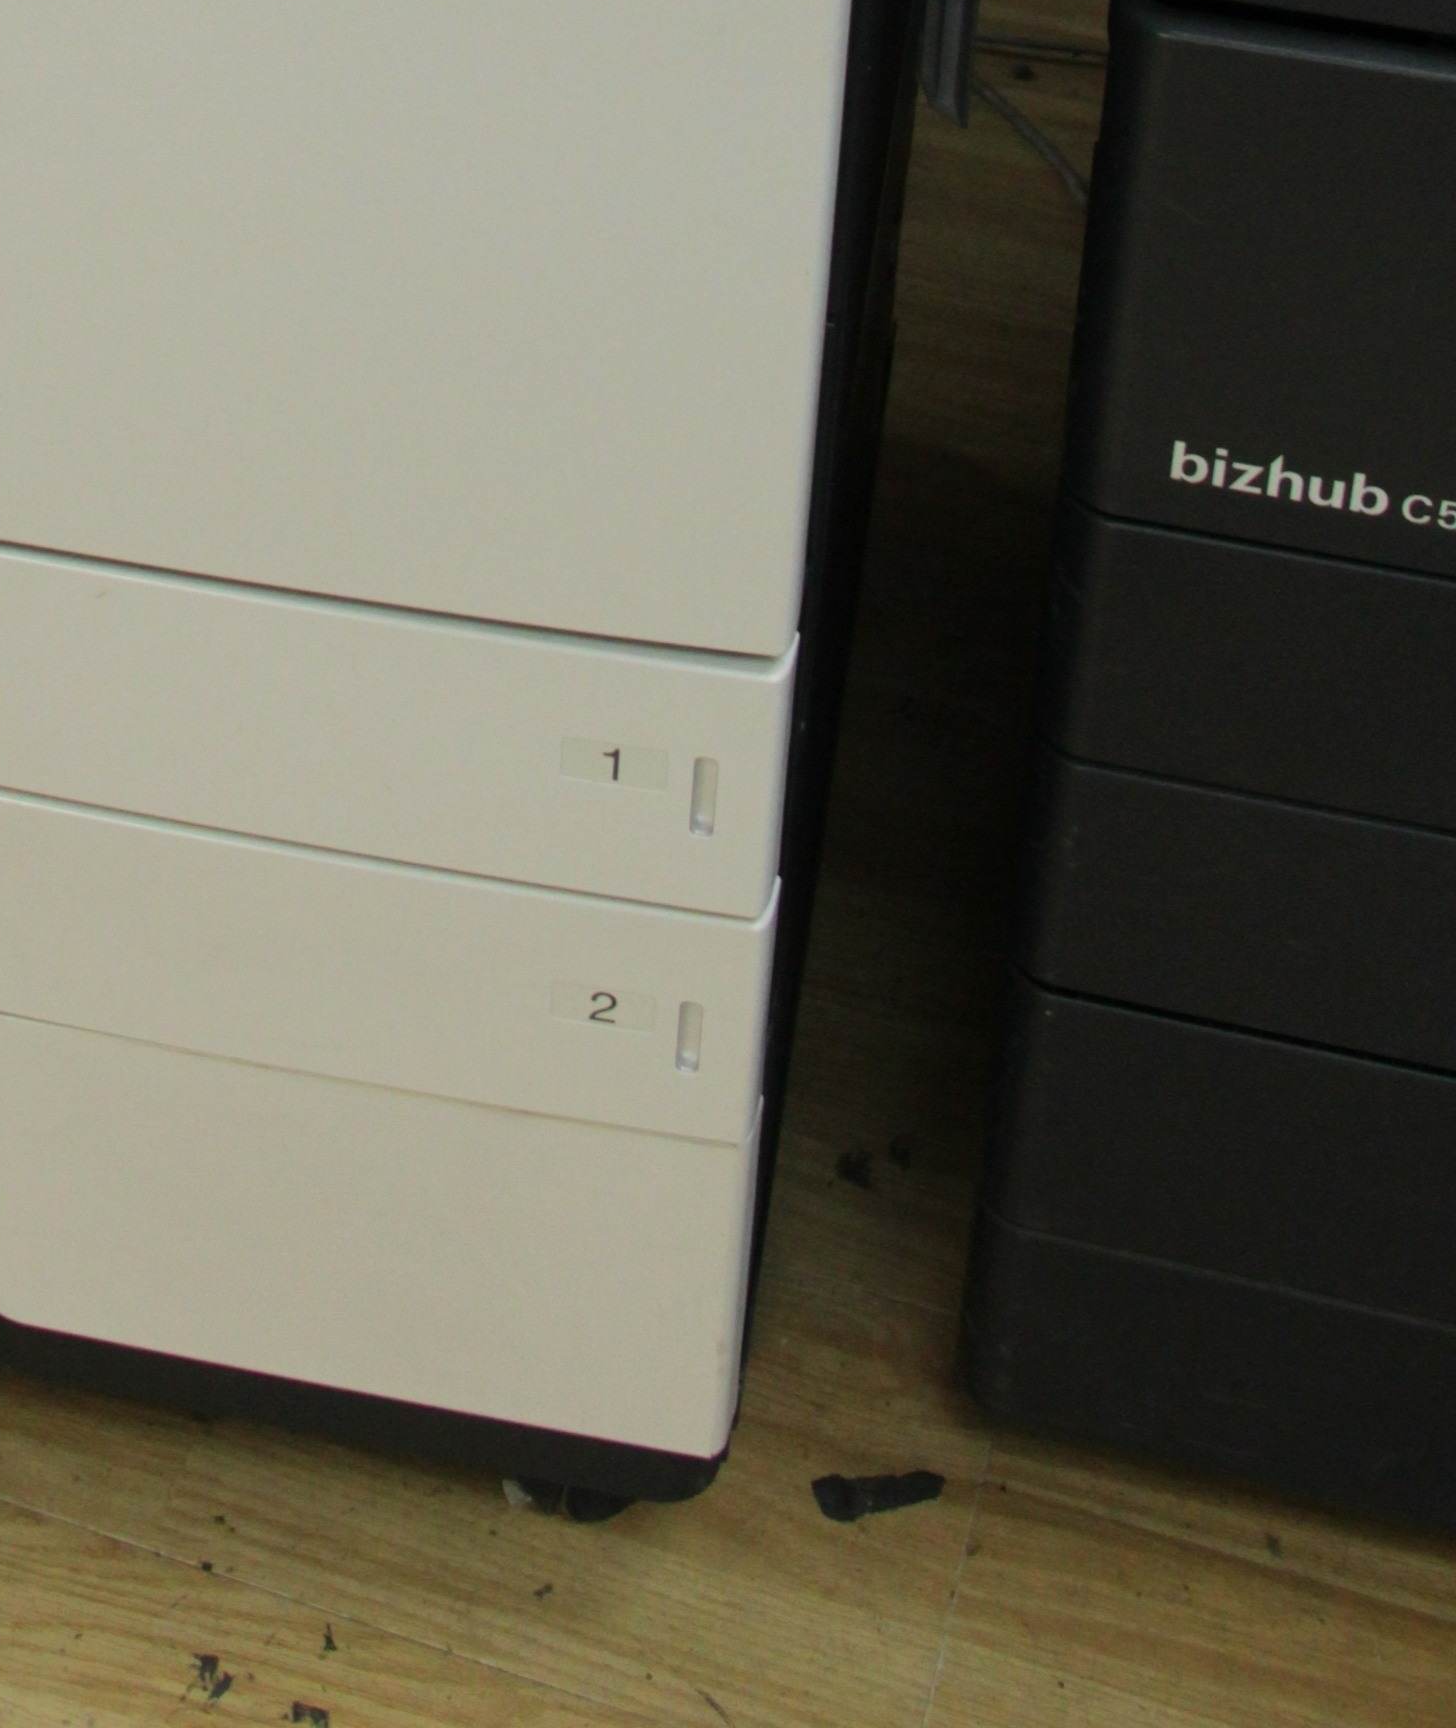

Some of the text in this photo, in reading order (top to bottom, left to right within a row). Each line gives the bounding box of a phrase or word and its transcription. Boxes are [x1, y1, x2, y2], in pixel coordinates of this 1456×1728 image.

[1169, 440, 1390, 517] bizhub
[602, 748, 622, 782] 1
[588, 992, 618, 1026] 2
